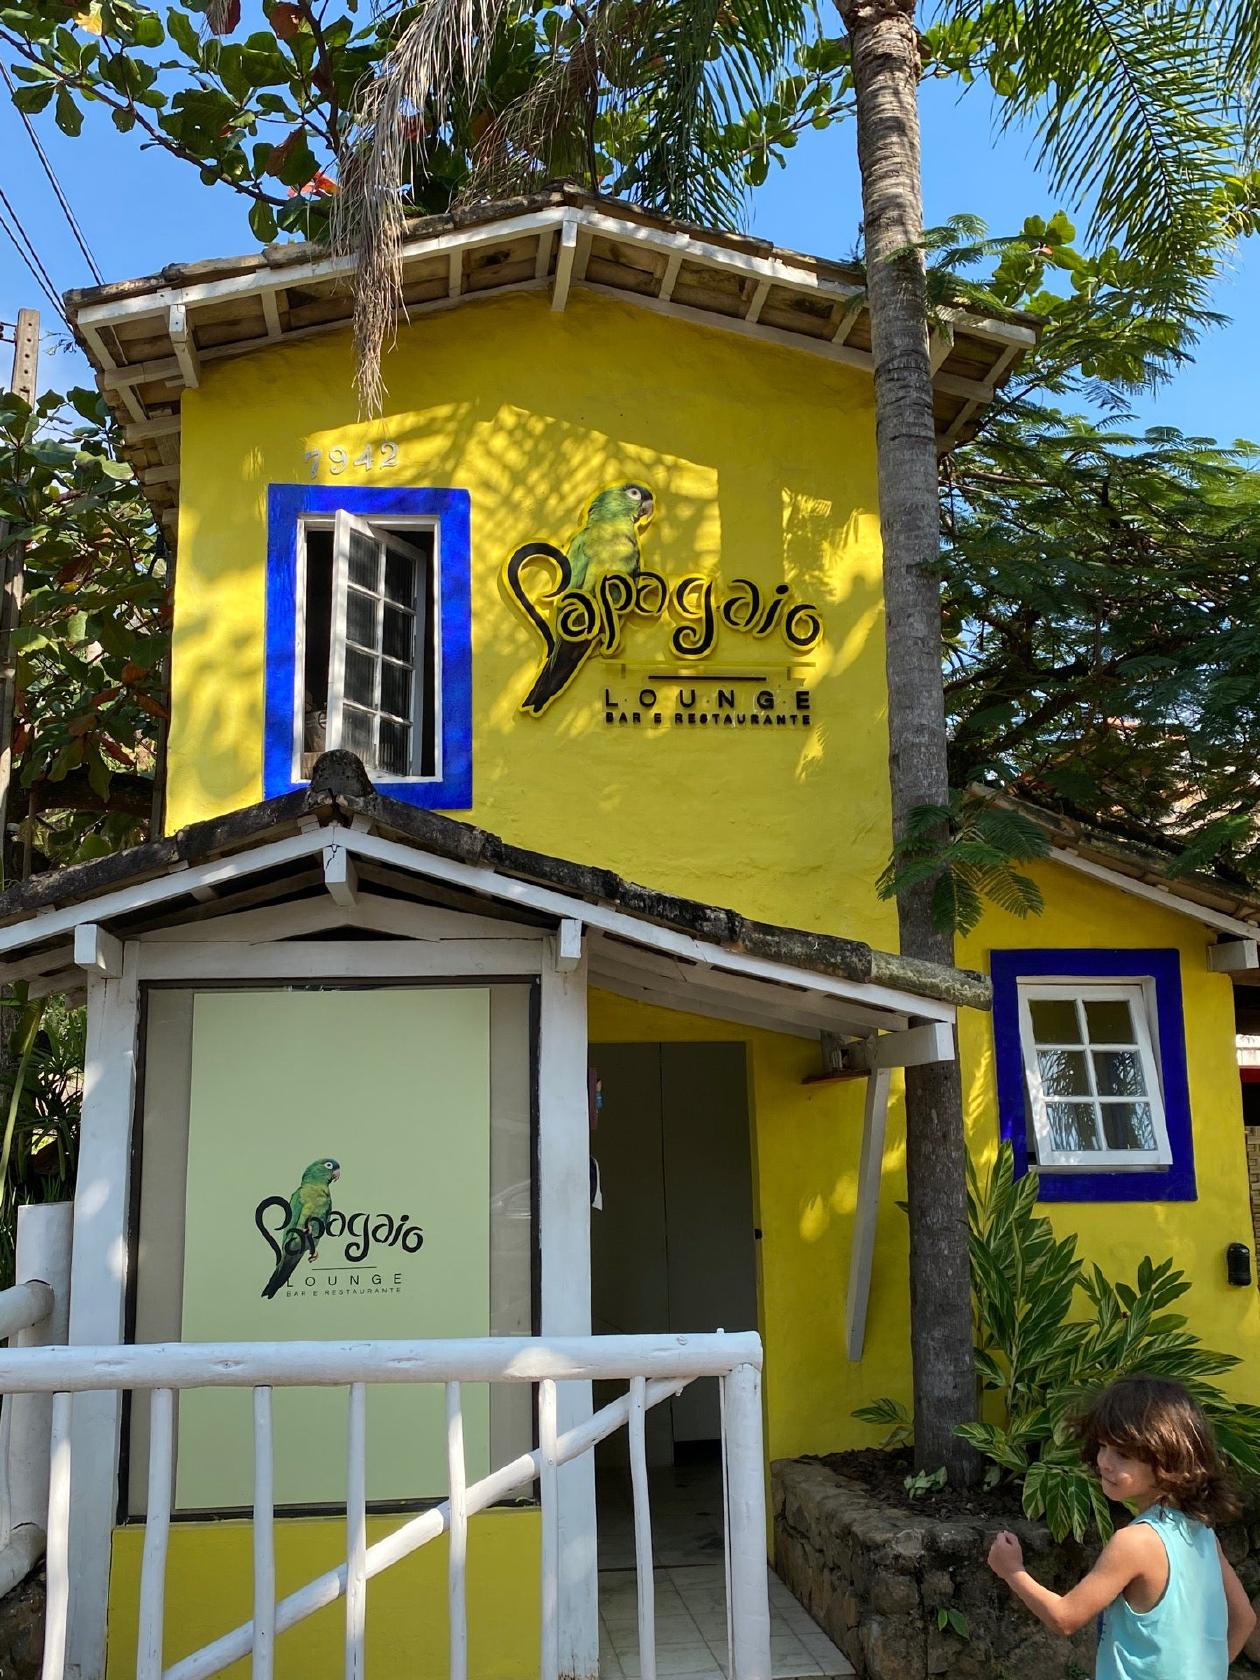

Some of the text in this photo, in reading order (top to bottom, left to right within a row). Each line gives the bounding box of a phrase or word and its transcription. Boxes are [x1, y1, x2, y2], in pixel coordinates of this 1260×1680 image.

[305, 441, 399, 480] 7942
[507, 541, 821, 658] Papagaio
[605, 688, 811, 710] LOUNGE
[605, 712, 811, 726] BAR E RESTAURANTE
[254, 1195, 424, 1266] Papagaio
[286, 1273, 402, 1288] LOUNGE
[286, 1290, 306, 1298] BAR
[324, 1287, 402, 1296] RESTAURANTE
